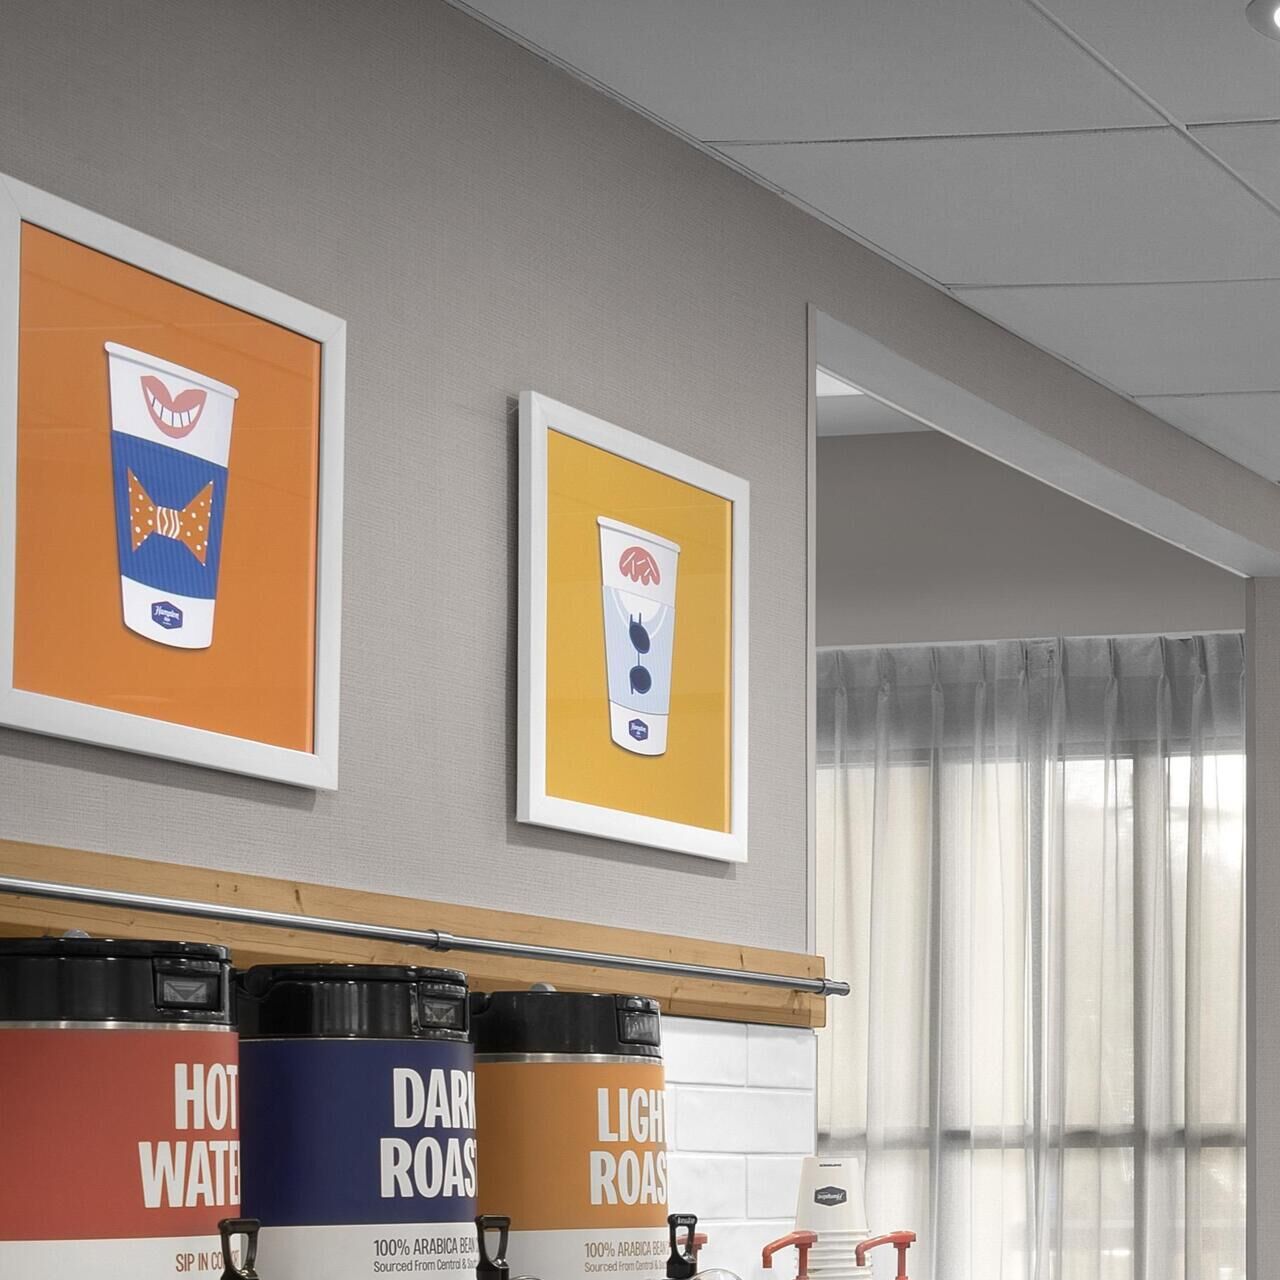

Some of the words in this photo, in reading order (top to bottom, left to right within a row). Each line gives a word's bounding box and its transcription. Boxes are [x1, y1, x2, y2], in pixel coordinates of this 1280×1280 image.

[174, 1063, 238, 1130] HOT
[597, 1087, 667, 1143] LIGH
[138, 1140, 241, 1208] WATE
[589, 1150, 669, 1206] ROAS
[374, 1238, 410, 1257] 100%
[413, 1238, 458, 1255] ARABICA
[460, 1237, 477, 1253] BEA
[585, 1242, 615, 1257] 100%
[618, 1241, 651, 1256] ARABICA
[175, 1252, 195, 1272] SIP
[198, 1252, 208, 1271] IN
[373, 1260, 413, 1273] Sourced
[414, 1260, 436, 1271] From
[584, 1261, 617, 1272] Sourced
